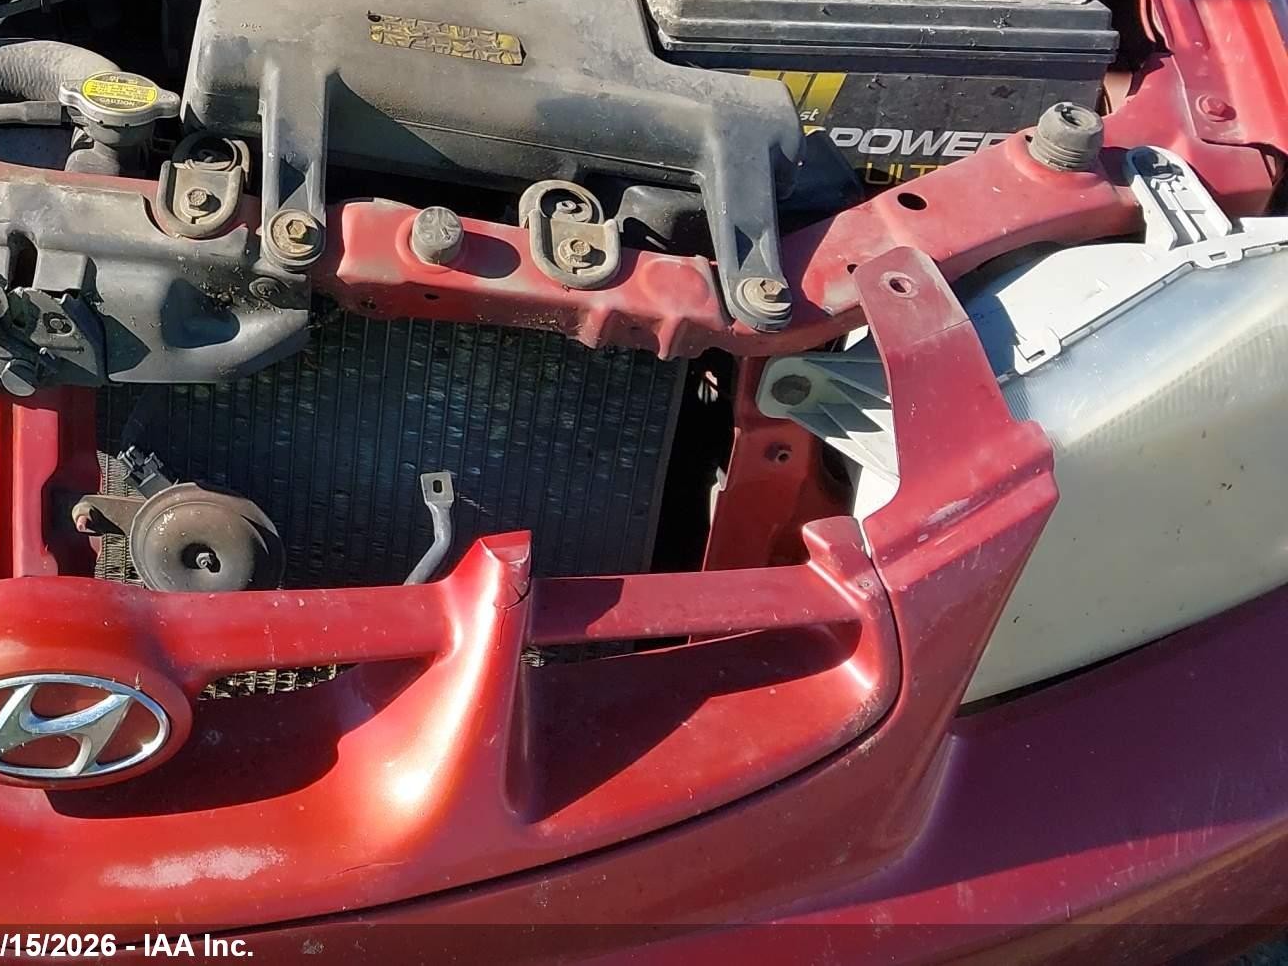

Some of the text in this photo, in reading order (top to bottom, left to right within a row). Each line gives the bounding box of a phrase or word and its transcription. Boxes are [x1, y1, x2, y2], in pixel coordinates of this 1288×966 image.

[99, 97, 136, 107] CAUTION
[799, 108, 819, 121] st
[865, 162, 947, 185] ULT
